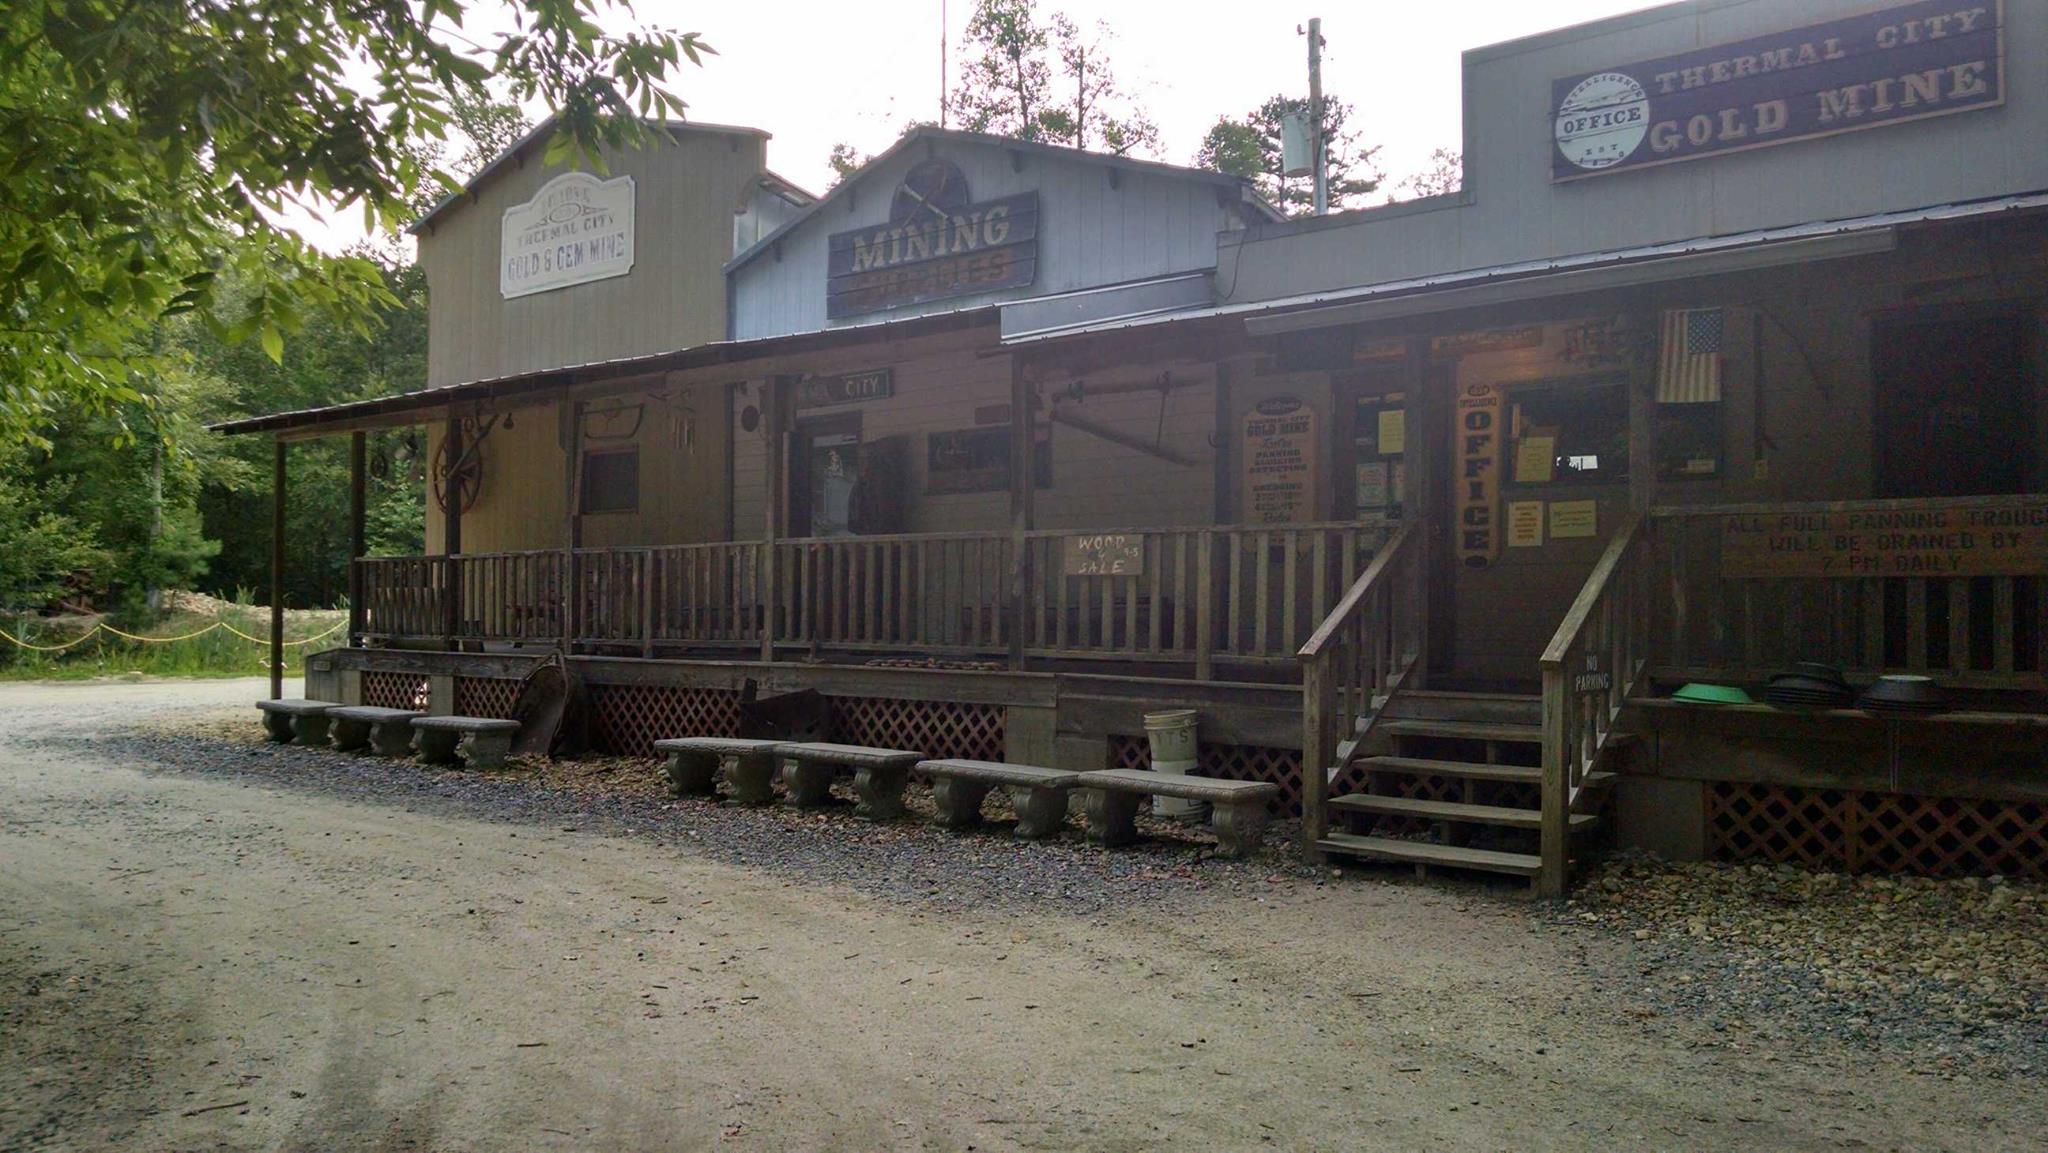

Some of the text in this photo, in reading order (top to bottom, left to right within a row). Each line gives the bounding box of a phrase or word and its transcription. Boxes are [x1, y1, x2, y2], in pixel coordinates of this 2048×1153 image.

[1655, 7, 1987, 94] THERMAL CITY
[1650, 61, 1987, 152] GOLD MINE
[1563, 107, 1642, 133] OFFICE
[517, 208, 616, 248] THERMAL CITY
[851, 205, 1010, 273] MINING
[507, 231, 625, 281] GOLD & GEM MINE
[845, 375, 879, 396] CITY
[1463, 411, 1492, 550] OFFICE
[1726, 509, 2048, 533] ALL FULL PANNING TROUG
[1078, 535, 1126, 550] WOOD
[1769, 531, 2022, 552] WILL BE DRAINED BY
[1078, 559, 1126, 574] SALE
[1850, 555, 1879, 571] PM
[1895, 553, 1963, 572] DAILY
[1586, 654, 1598, 672] NO
[1575, 672, 1609, 692] PARKING
